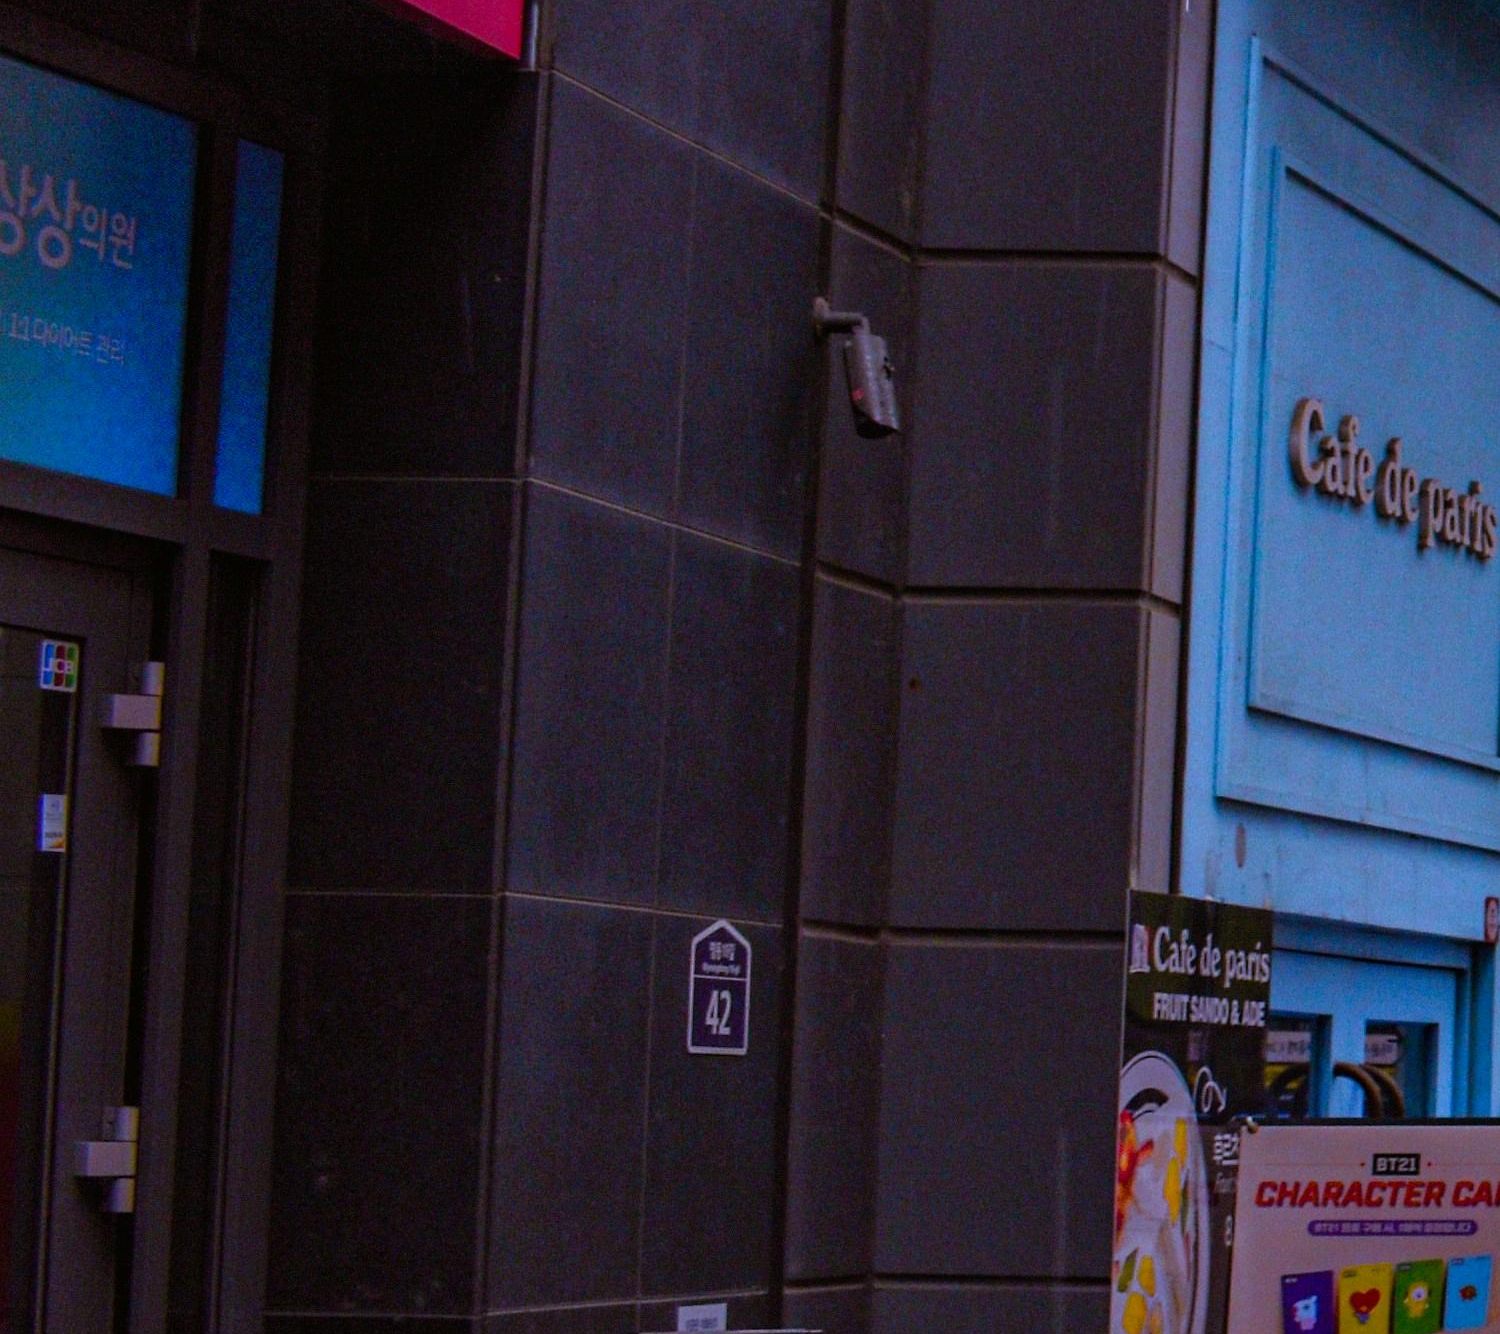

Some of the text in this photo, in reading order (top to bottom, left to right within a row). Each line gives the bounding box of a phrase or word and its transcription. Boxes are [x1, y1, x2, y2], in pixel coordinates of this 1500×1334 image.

[1291, 397, 1497, 559] Cafe de paris
[1153, 925, 1271, 987] Cafe de paris
[705, 990, 732, 1037] 42
[1153, 992, 1266, 1028] FRUIT ADE
[1254, 1180, 1443, 1208] CHARACTER
